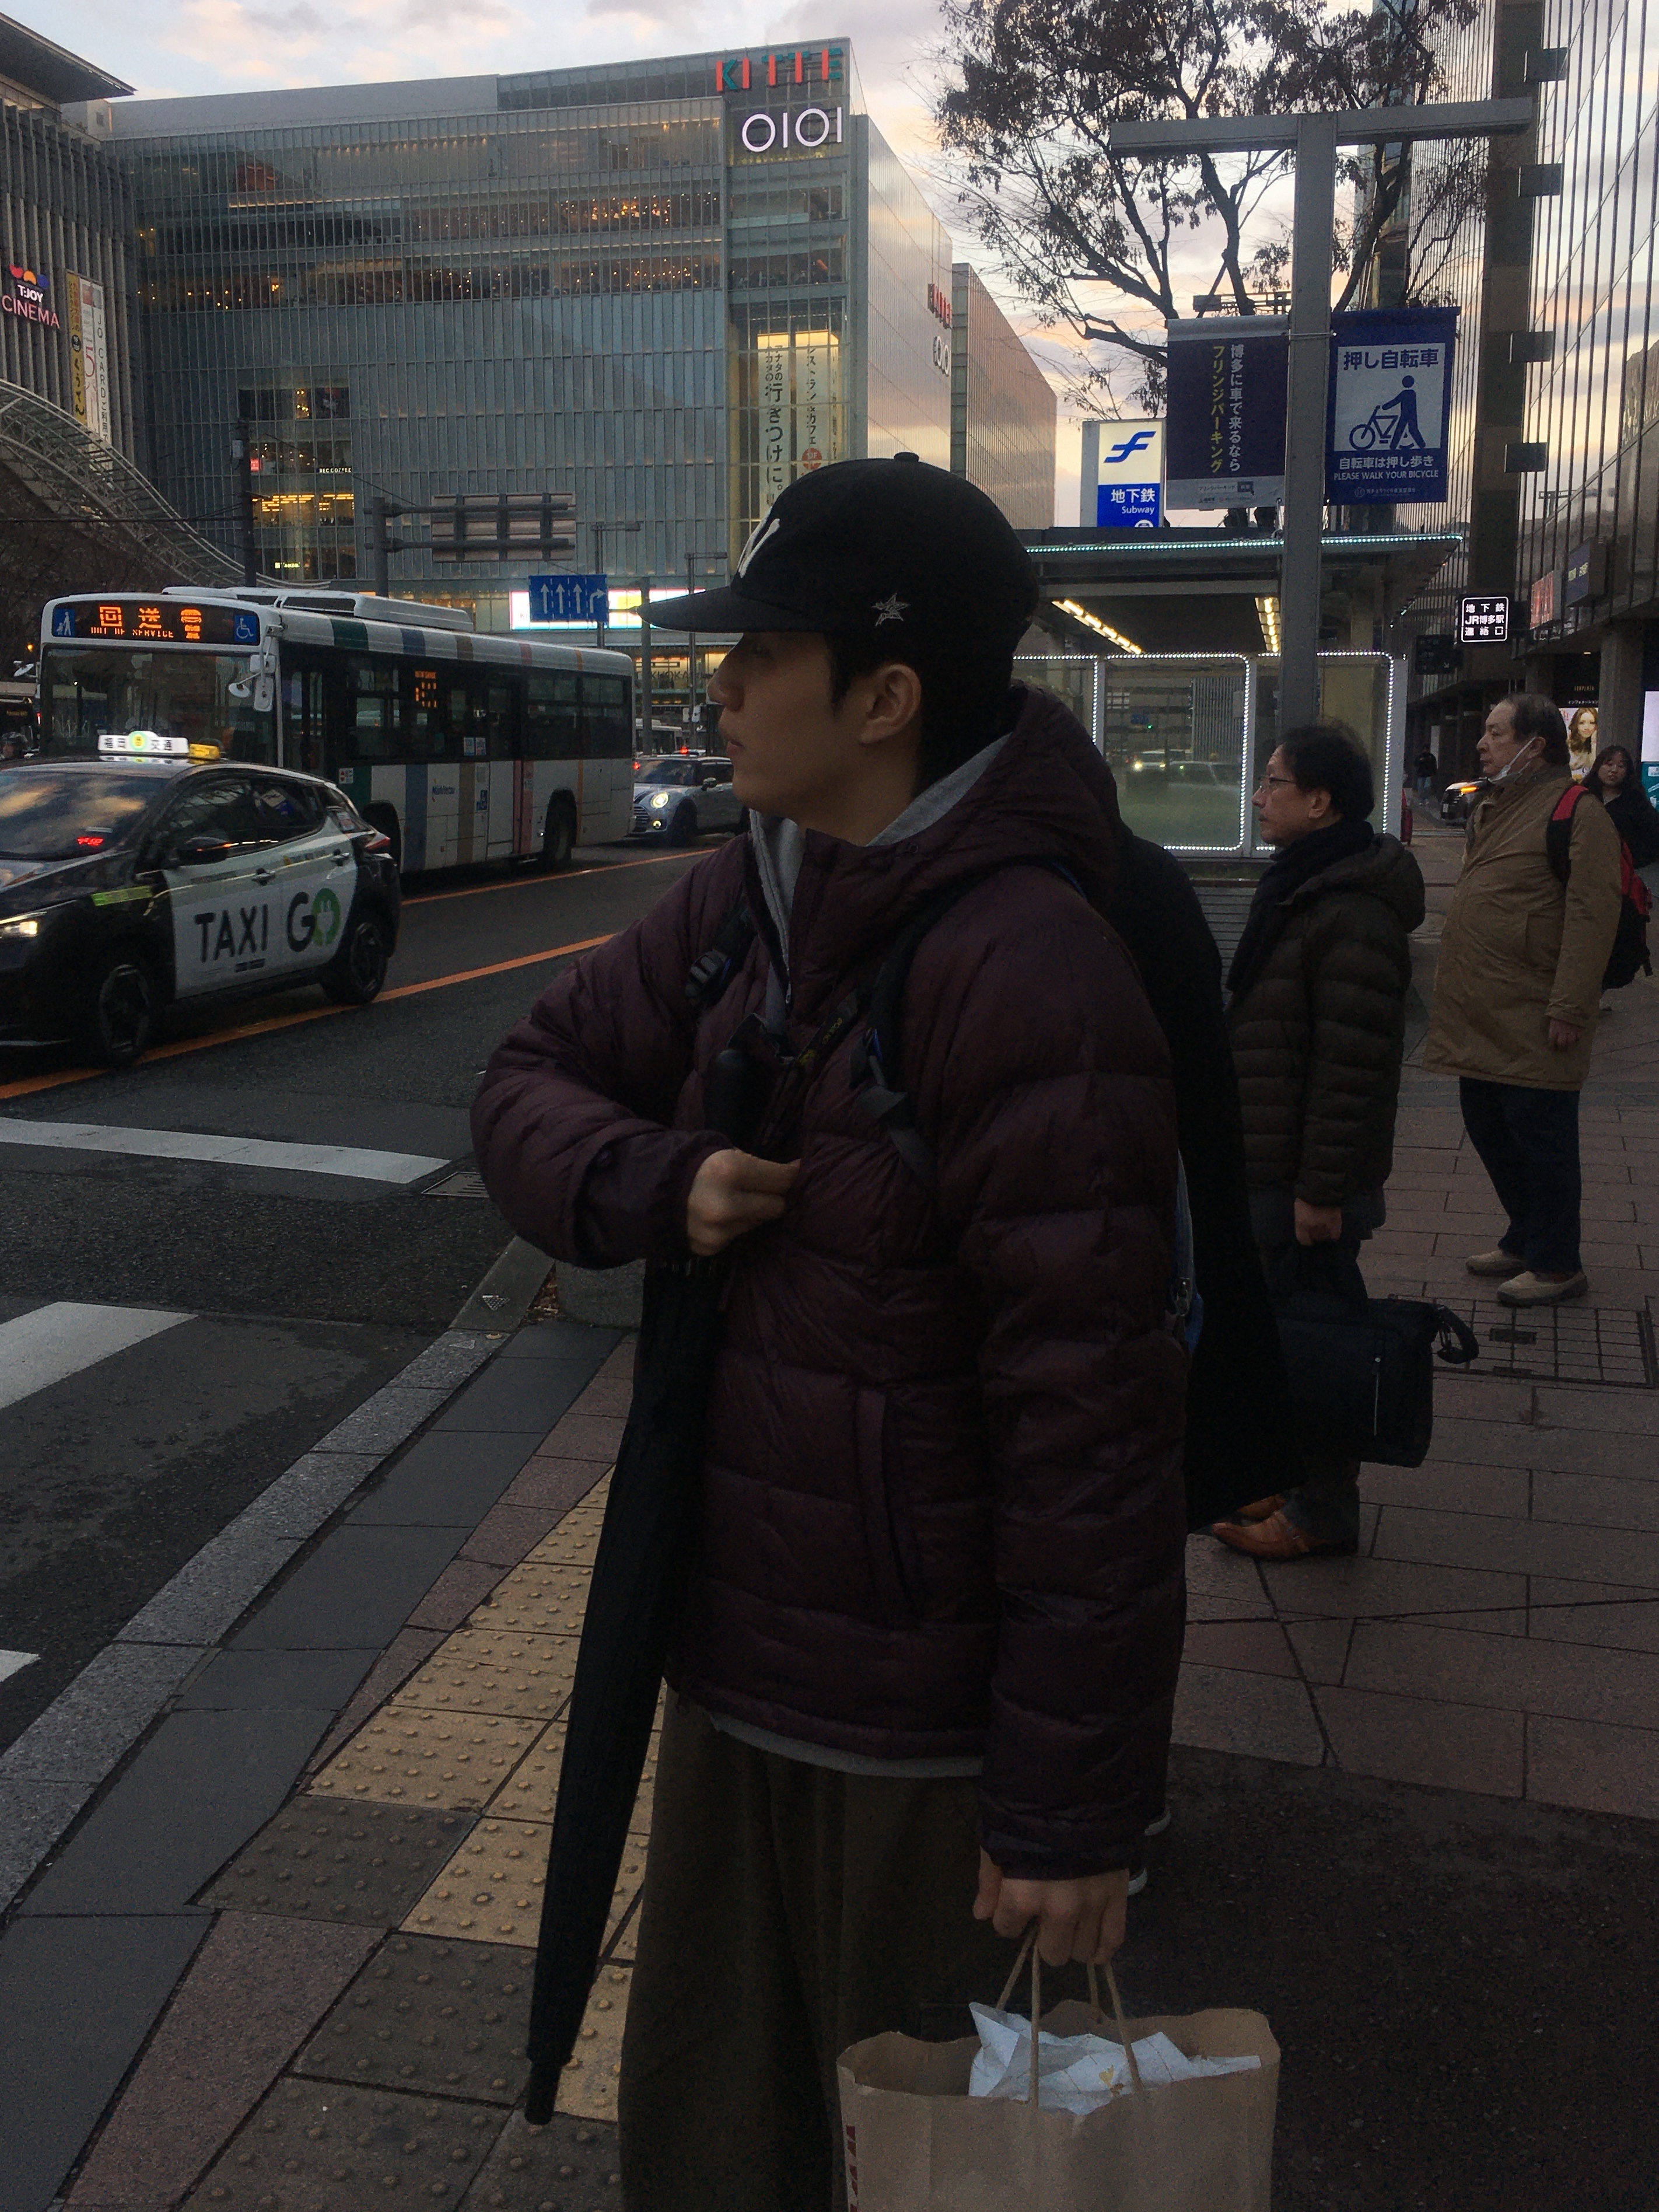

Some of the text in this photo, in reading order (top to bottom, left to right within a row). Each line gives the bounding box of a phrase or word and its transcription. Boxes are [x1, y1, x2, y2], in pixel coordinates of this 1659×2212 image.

[716, 48, 843, 92] KITTE
[2, 295, 60, 329] CINEMA
[1343, 348, 1439, 371] 押し自転車
[1211, 345, 1225, 473] フリンジパーキング
[1228, 344, 1244, 471] 博多に車で来るなら
[1339, 455, 1434, 470] 自転車は押し歩き
[1334, 470, 1439, 481] PLEASE WALK YOUR BICYCLE
[1111, 488, 1155, 504] 地下鉄
[1122, 506, 1155, 515] Subway
[99, 606, 162, 629] 回送
[1465, 603, 1505, 613] 地下鉄
[1465, 614, 1504, 625] JR博多駅
[1465, 627, 1504, 637] 連絡口
[194, 887, 341, 963] TAXI GO
